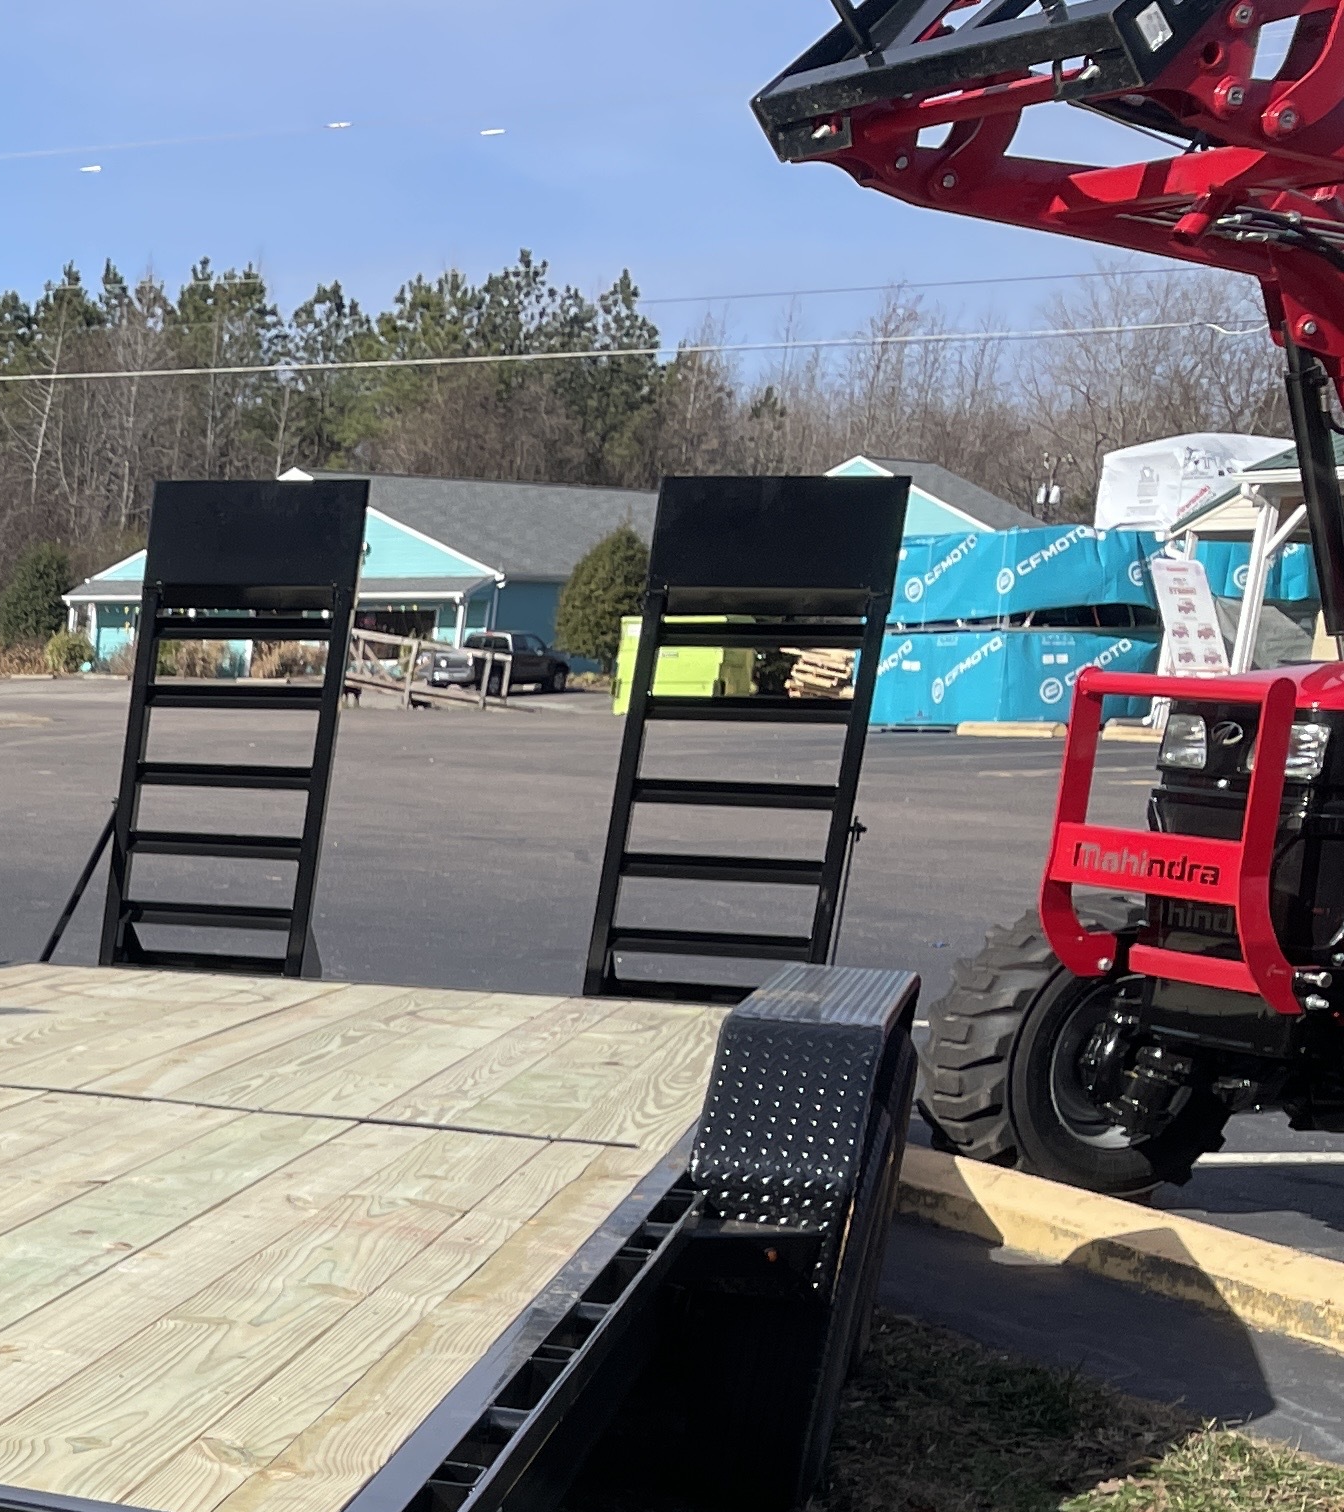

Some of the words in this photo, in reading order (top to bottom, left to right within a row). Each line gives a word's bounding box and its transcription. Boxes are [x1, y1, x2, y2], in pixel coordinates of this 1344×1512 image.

[923, 533, 979, 586] CFMOTO
[1015, 524, 1089, 577] CFMOTO
[877, 638, 913, 677] MOTO
[944, 636, 1005, 687] CFMOTO
[1064, 638, 1133, 686] CMOTO
[1072, 842, 1221, 887] Mahindra
